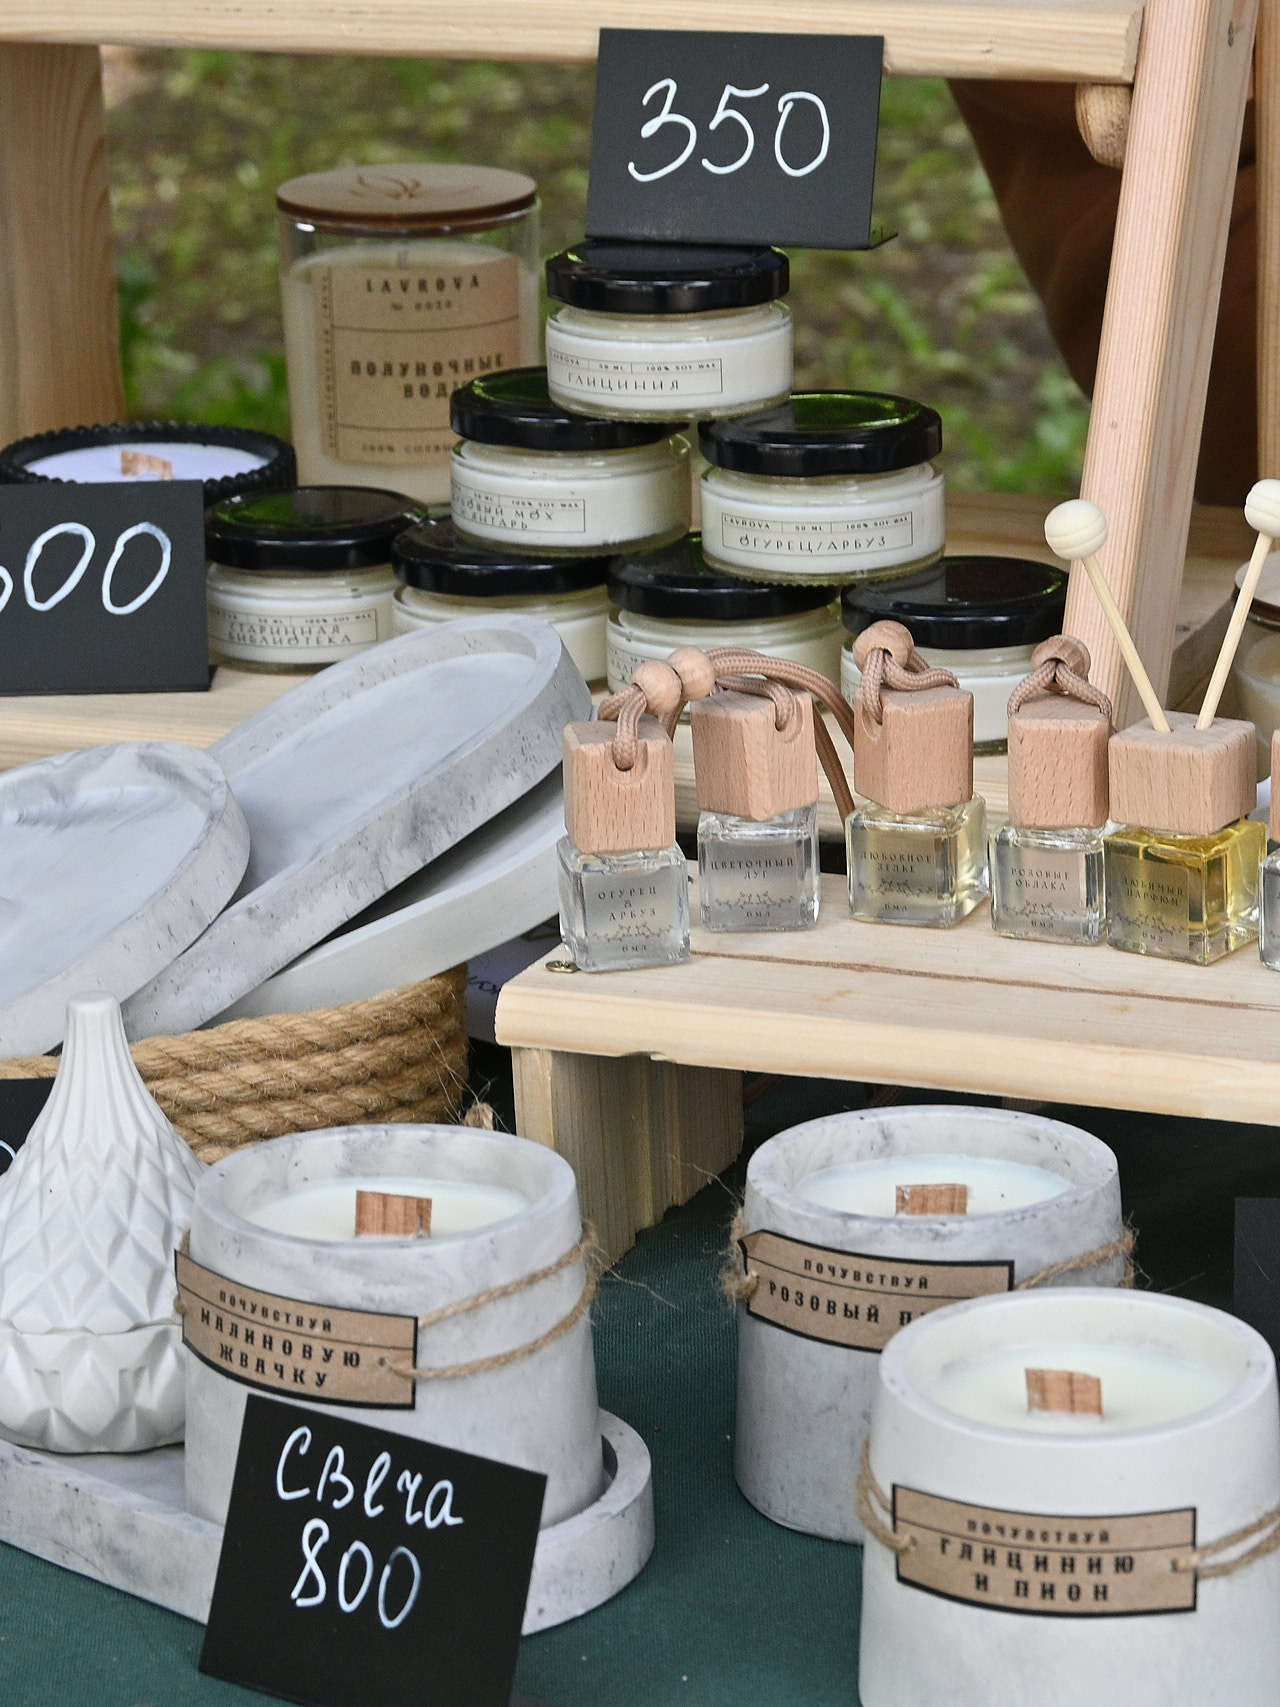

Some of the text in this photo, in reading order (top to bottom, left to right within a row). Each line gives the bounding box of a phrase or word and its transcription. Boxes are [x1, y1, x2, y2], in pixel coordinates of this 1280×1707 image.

[628, 78, 829, 182] 350
[366, 275, 480, 293] LAVROVA
[567, 371, 680, 392] ГЛИЦИНИЯ
[514, 508, 554, 521] МОХ
[723, 515, 771, 530] LAVROVA
[846, 523, 869, 531] 100%
[0, 521, 172, 615] 00
[229, 620, 341, 636] СТАРИННАЯ
[228, 630, 351, 646] БИБЛИОТЕКА
[711, 858, 794, 870] ЦВЕТОЧНЫЙ
[861, 851, 931, 863] ЛЮБОВНОЕ
[744, 870, 767, 879] ЛУГ
[877, 863, 915, 873] ЗЕЛЬЕ
[1011, 867, 1070, 881] РОЗОВЫЕ
[598, 886, 657, 900] ОГУРЕЦ
[1015, 879, 1067, 891] ОБЛАКА
[1127, 888, 1179, 907] ПАРФЮМ
[609, 908, 656, 921] АРБУЗ
[768, 1280, 880, 1324] РОЗОВЫЙ
[201, 1306, 361, 1368] МАЛИНОВУЮ
[220, 1342, 328, 1388] ЖВАЧКУ
[939, 1537, 1134, 1575] ГЛИЦИНИЮ
[291, 1517, 422, 1629] 800
[975, 1571, 1109, 1602] И ПИОН
